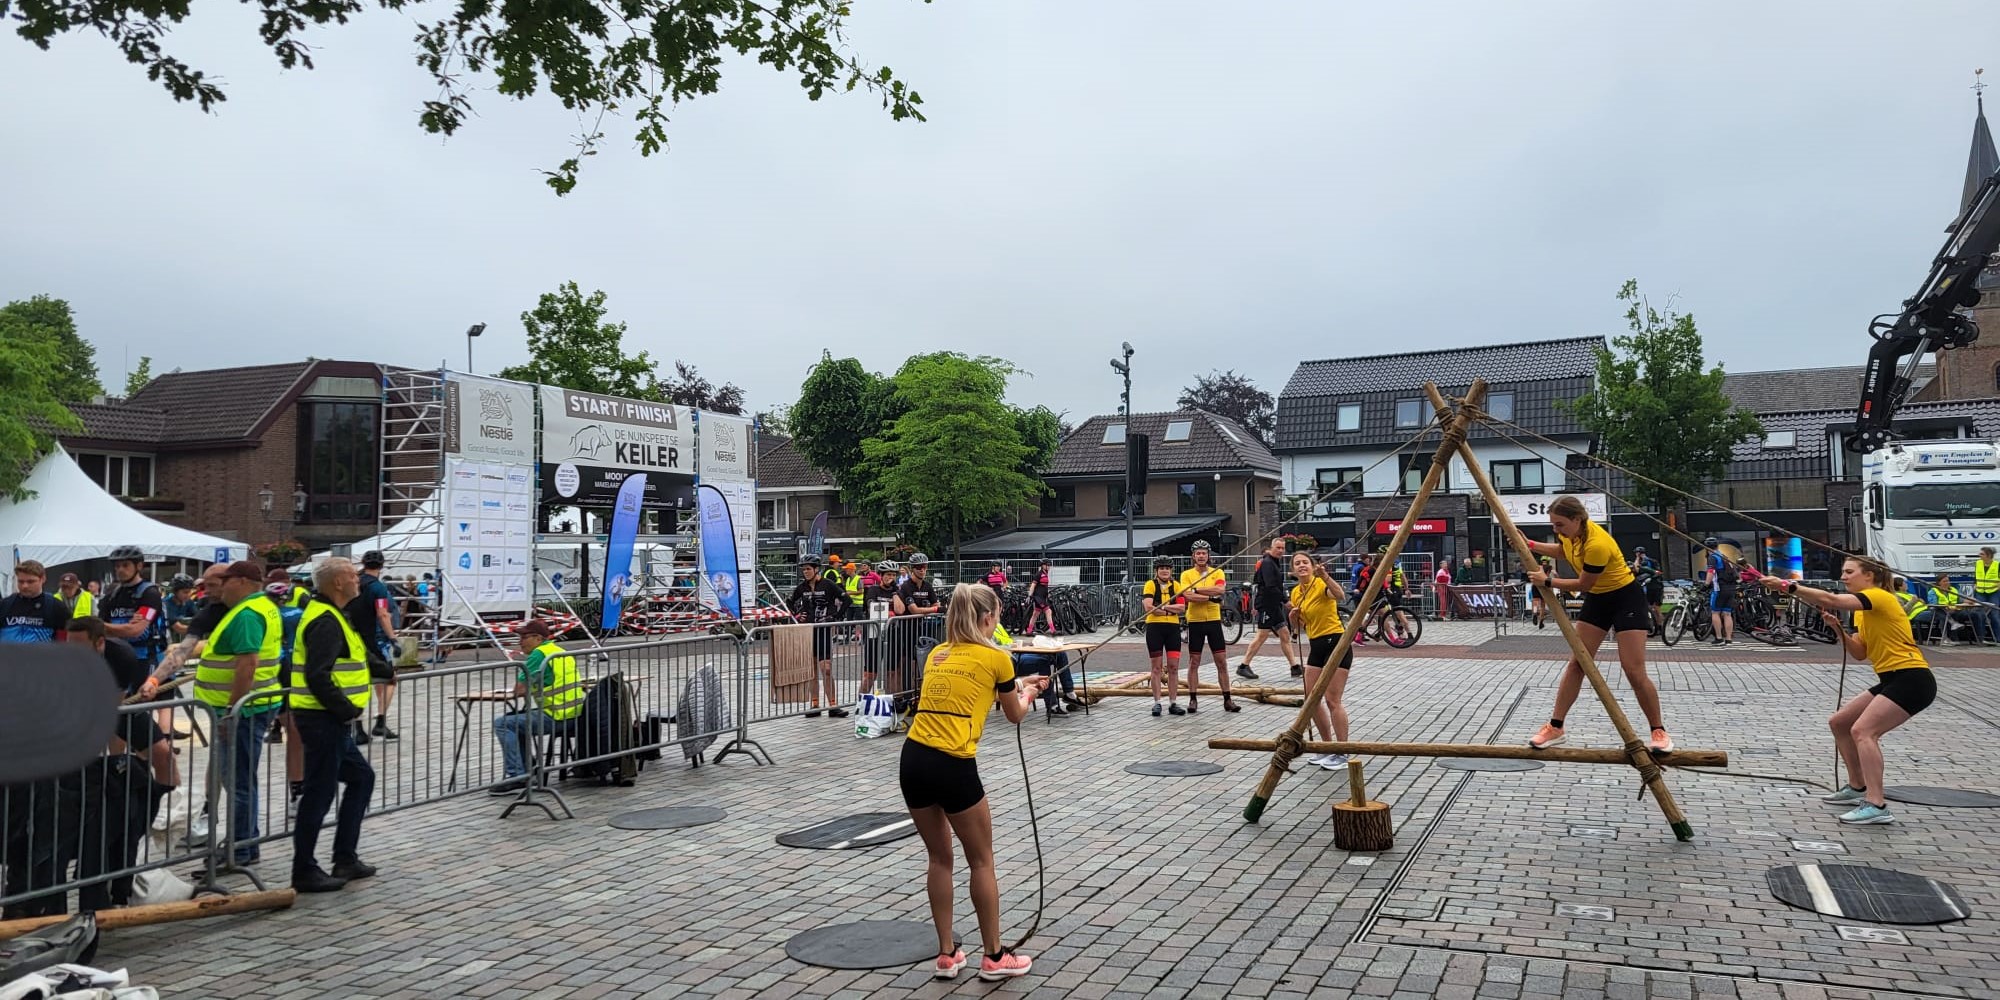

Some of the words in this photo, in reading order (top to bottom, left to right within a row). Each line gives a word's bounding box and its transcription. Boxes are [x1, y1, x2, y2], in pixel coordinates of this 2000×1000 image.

[570, 395, 619, 417] START
[626, 403, 673, 424] FINISH
[614, 429, 625, 440] DE
[628, 431, 679, 446] NUNSPEETSE
[616, 441, 679, 468] KEILER
[1928, 532, 1995, 540] VOLVO
[217, 550, 225, 563] P
